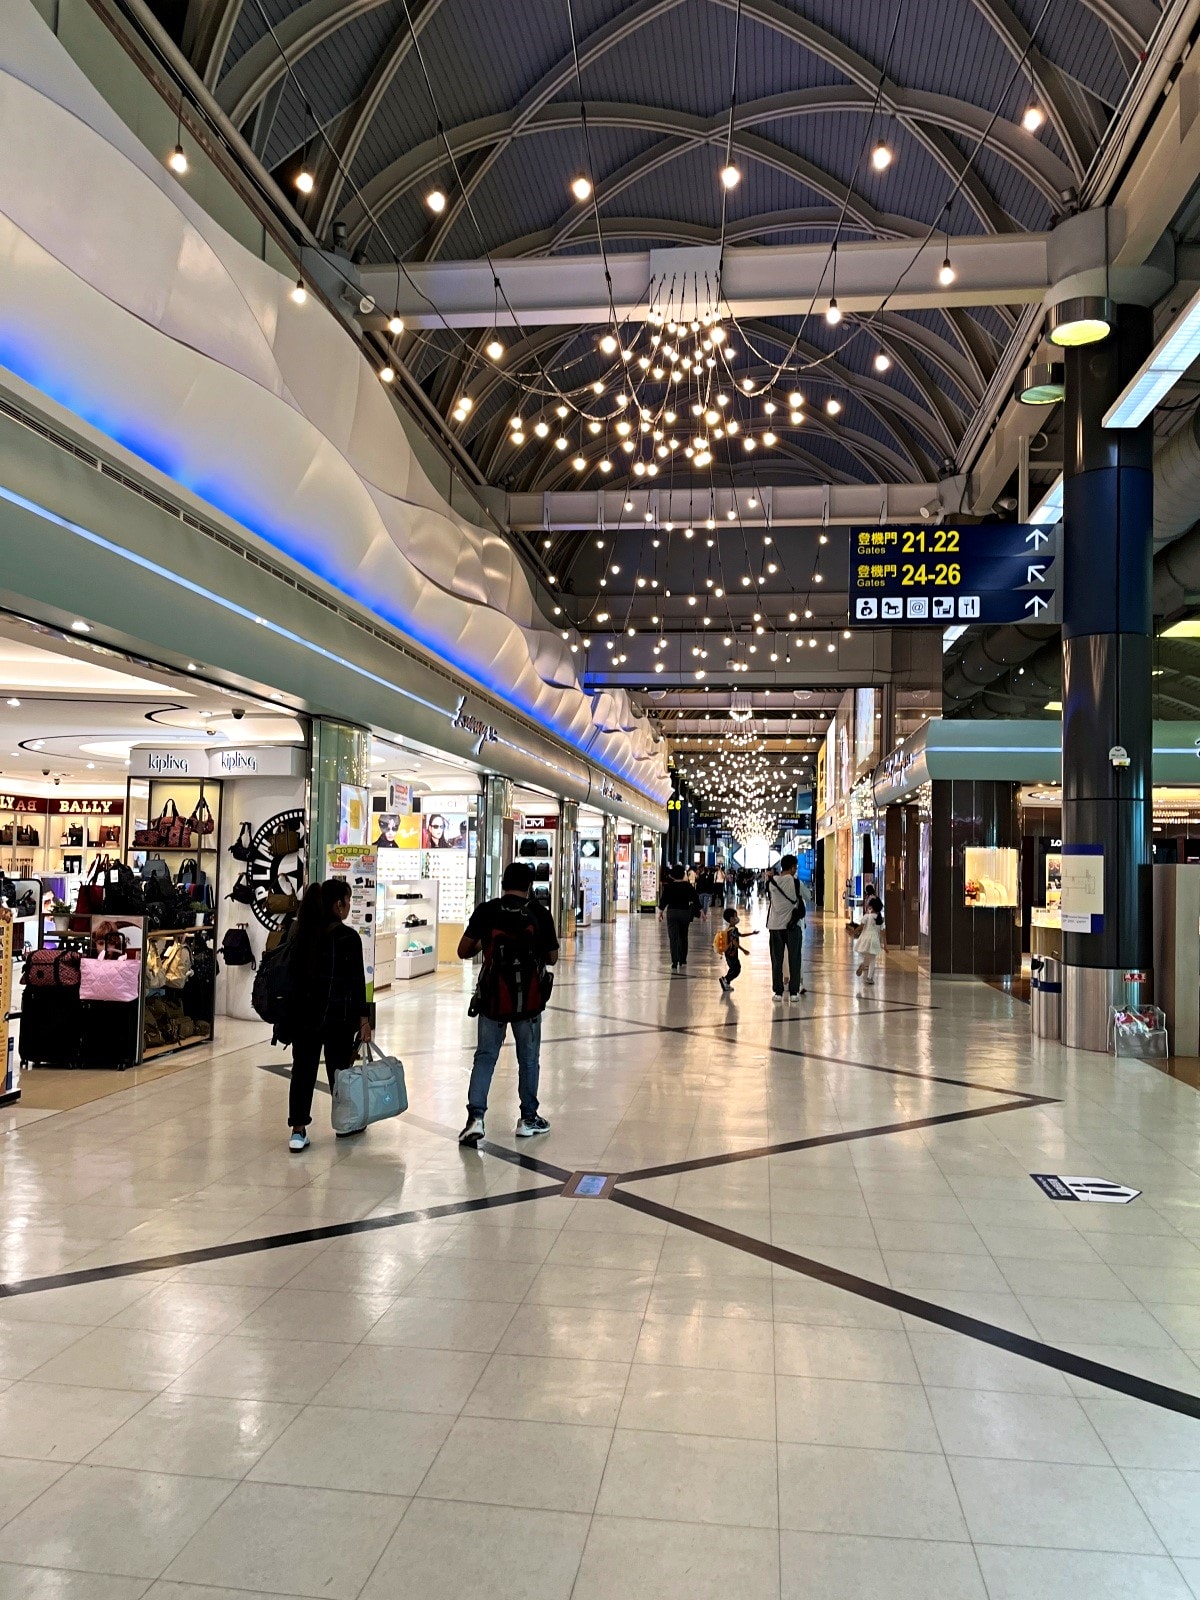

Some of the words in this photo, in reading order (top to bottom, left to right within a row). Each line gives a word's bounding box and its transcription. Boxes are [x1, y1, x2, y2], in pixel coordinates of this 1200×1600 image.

[858, 532, 897, 545] 登機門
[902, 531, 960, 553] 21.22
[857, 546, 886, 555] Gates
[857, 564, 897, 578] 登機門
[902, 563, 961, 586] 24-26
[857, 579, 886, 587] Gates
[148, 753, 189, 773] kipling
[221, 751, 257, 771] kipling
[59, 800, 112, 813] BALLY
[667, 800, 681, 810] 26
